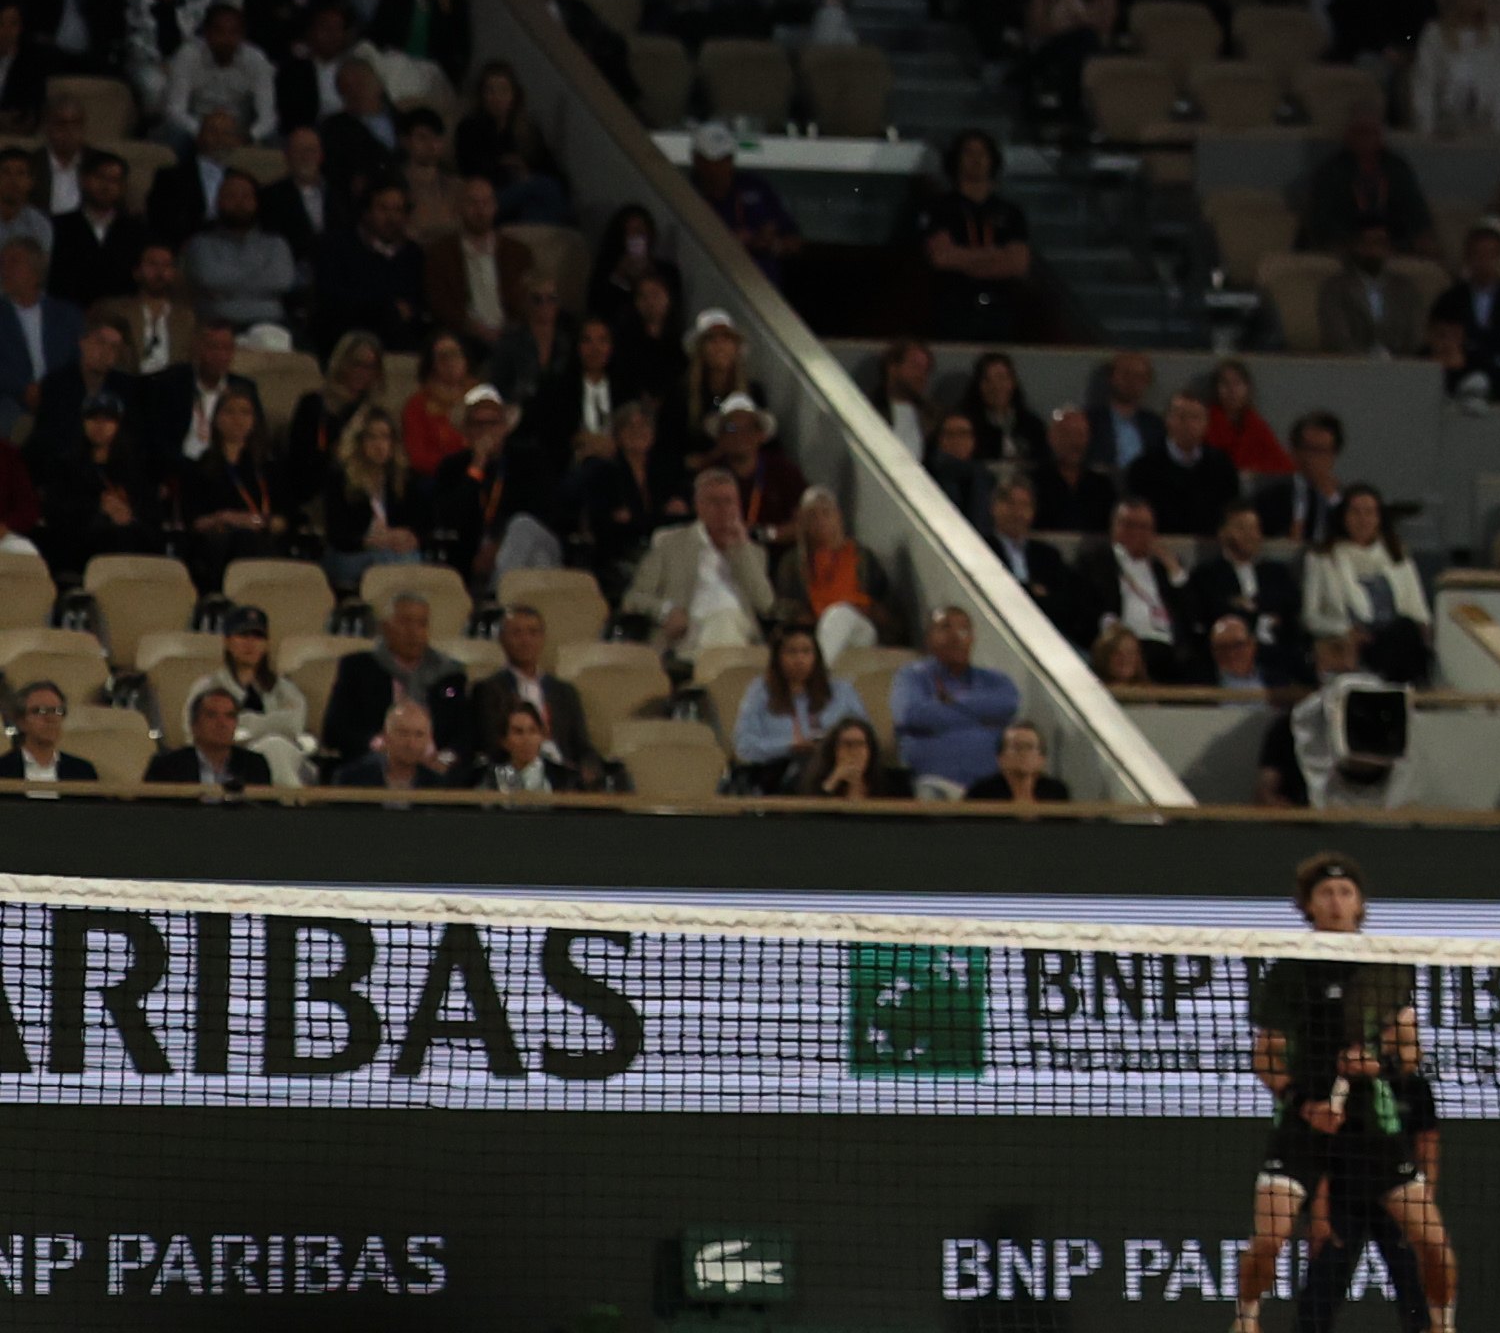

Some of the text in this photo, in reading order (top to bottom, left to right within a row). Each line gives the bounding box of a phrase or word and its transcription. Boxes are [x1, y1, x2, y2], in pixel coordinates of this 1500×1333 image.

[0, 907, 643, 1079] RIBAS
[1024, 949, 1211, 1021] BNP
[106, 1233, 447, 1295] PARIBAS
[942, 1238, 1102, 1301] BNP
